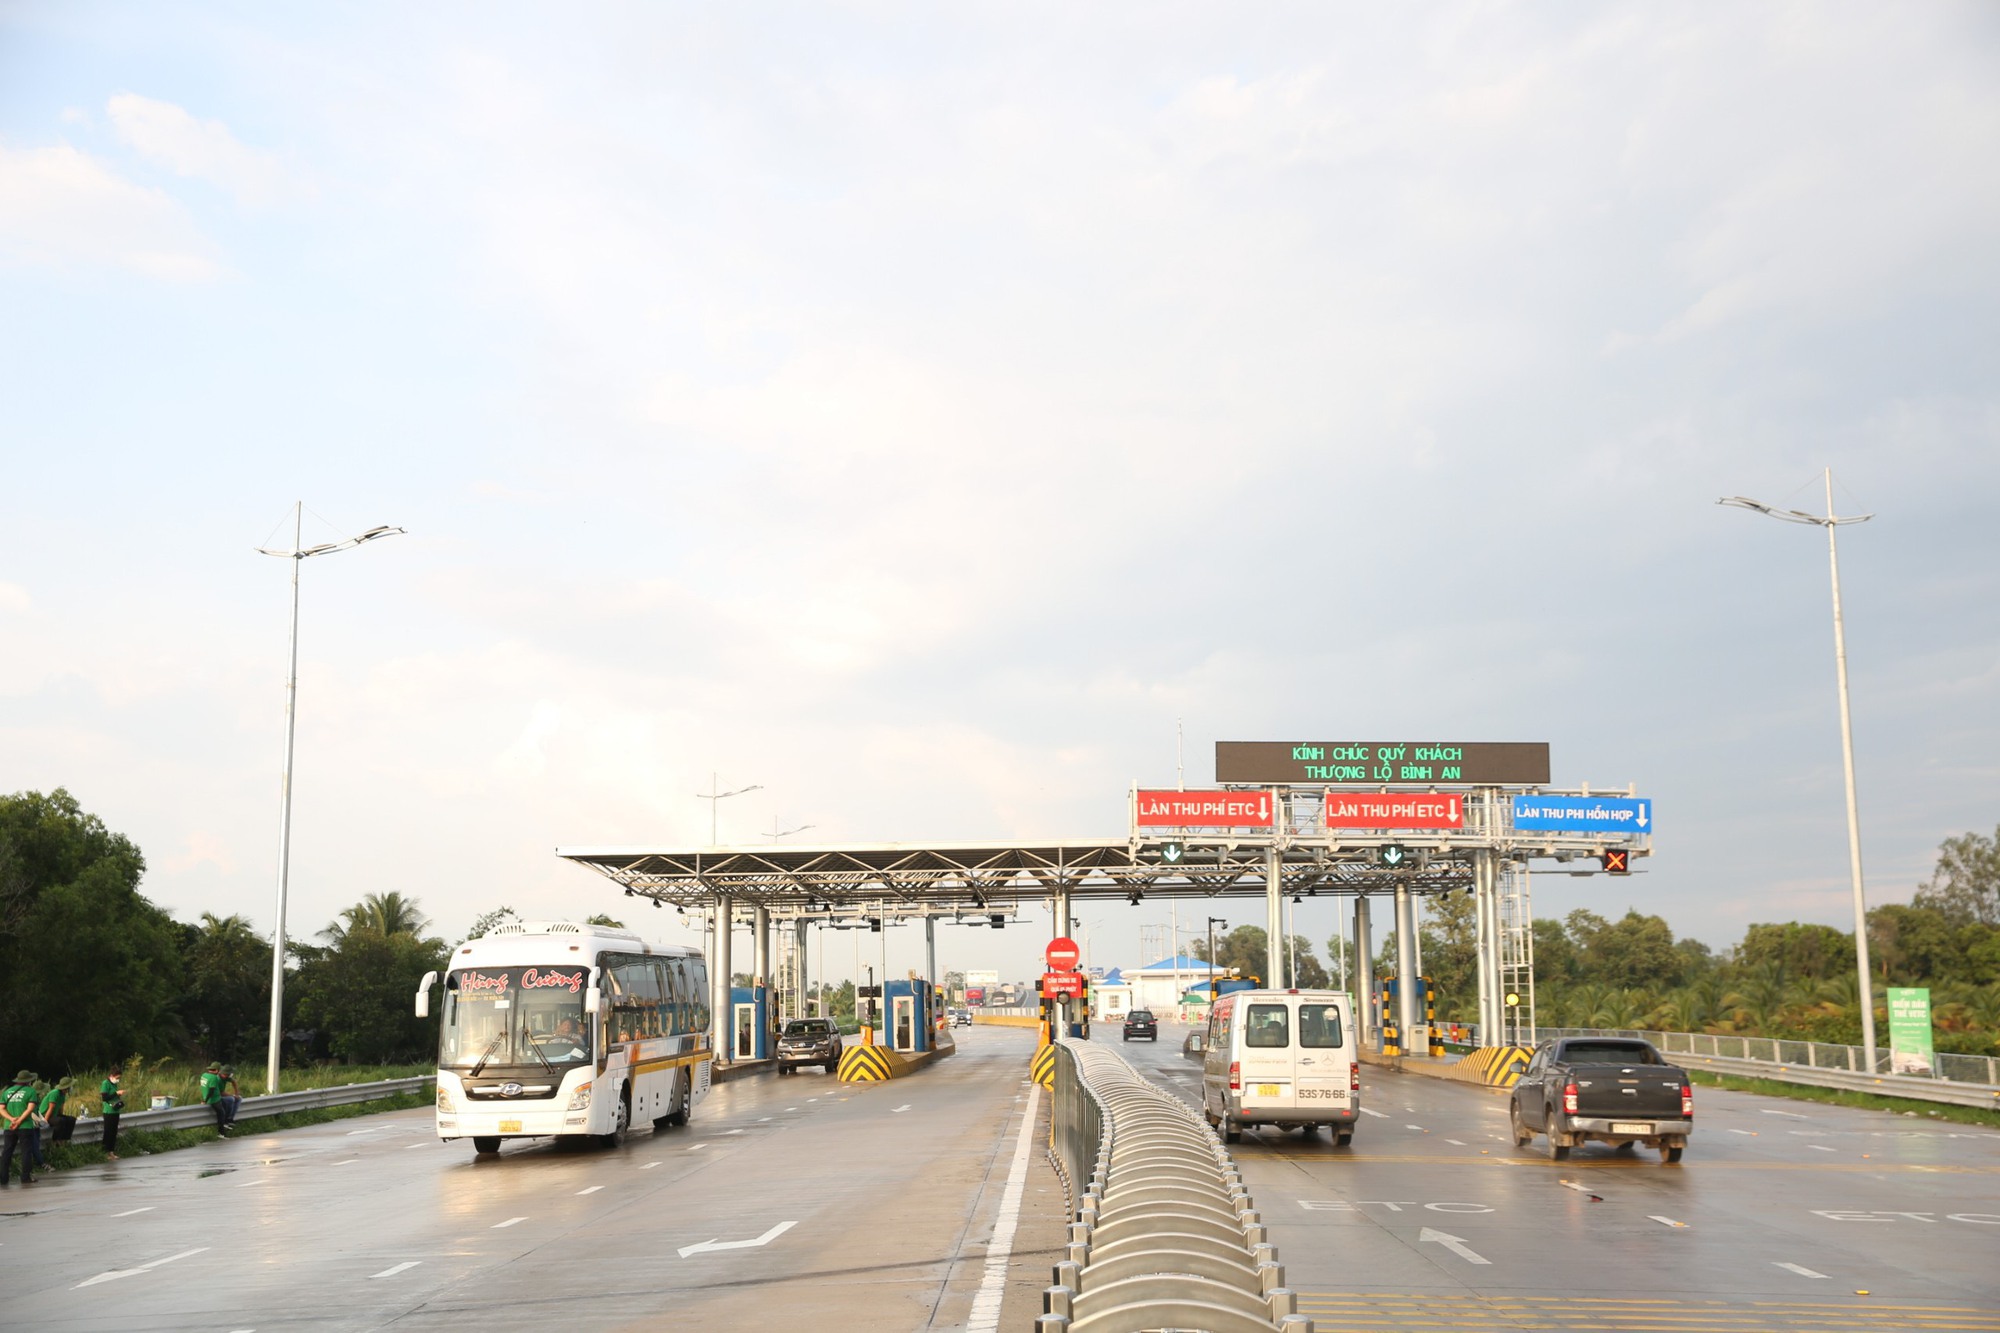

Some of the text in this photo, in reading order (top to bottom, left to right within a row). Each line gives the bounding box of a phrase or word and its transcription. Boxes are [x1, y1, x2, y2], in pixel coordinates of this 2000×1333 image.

[1292, 743, 1462, 762] KÍNH CHÚC QUÝ KHÁCH
[1304, 761, 1461, 781] THƯỢNG LỘ BÌNH AN
[1140, 798, 1255, 816] LÀN THU PHÍ ETC
[1329, 800, 1445, 817] LÀN THU PHÍ ETC
[1516, 804, 1540, 818] LÀN
[1542, 808, 1564, 819] THU
[1586, 805, 1609, 820] HỖN
[1611, 809, 1634, 822] HỢP
[461, 971, 508, 994] Hùng
[1297, 1200, 1495, 1213] ETC
